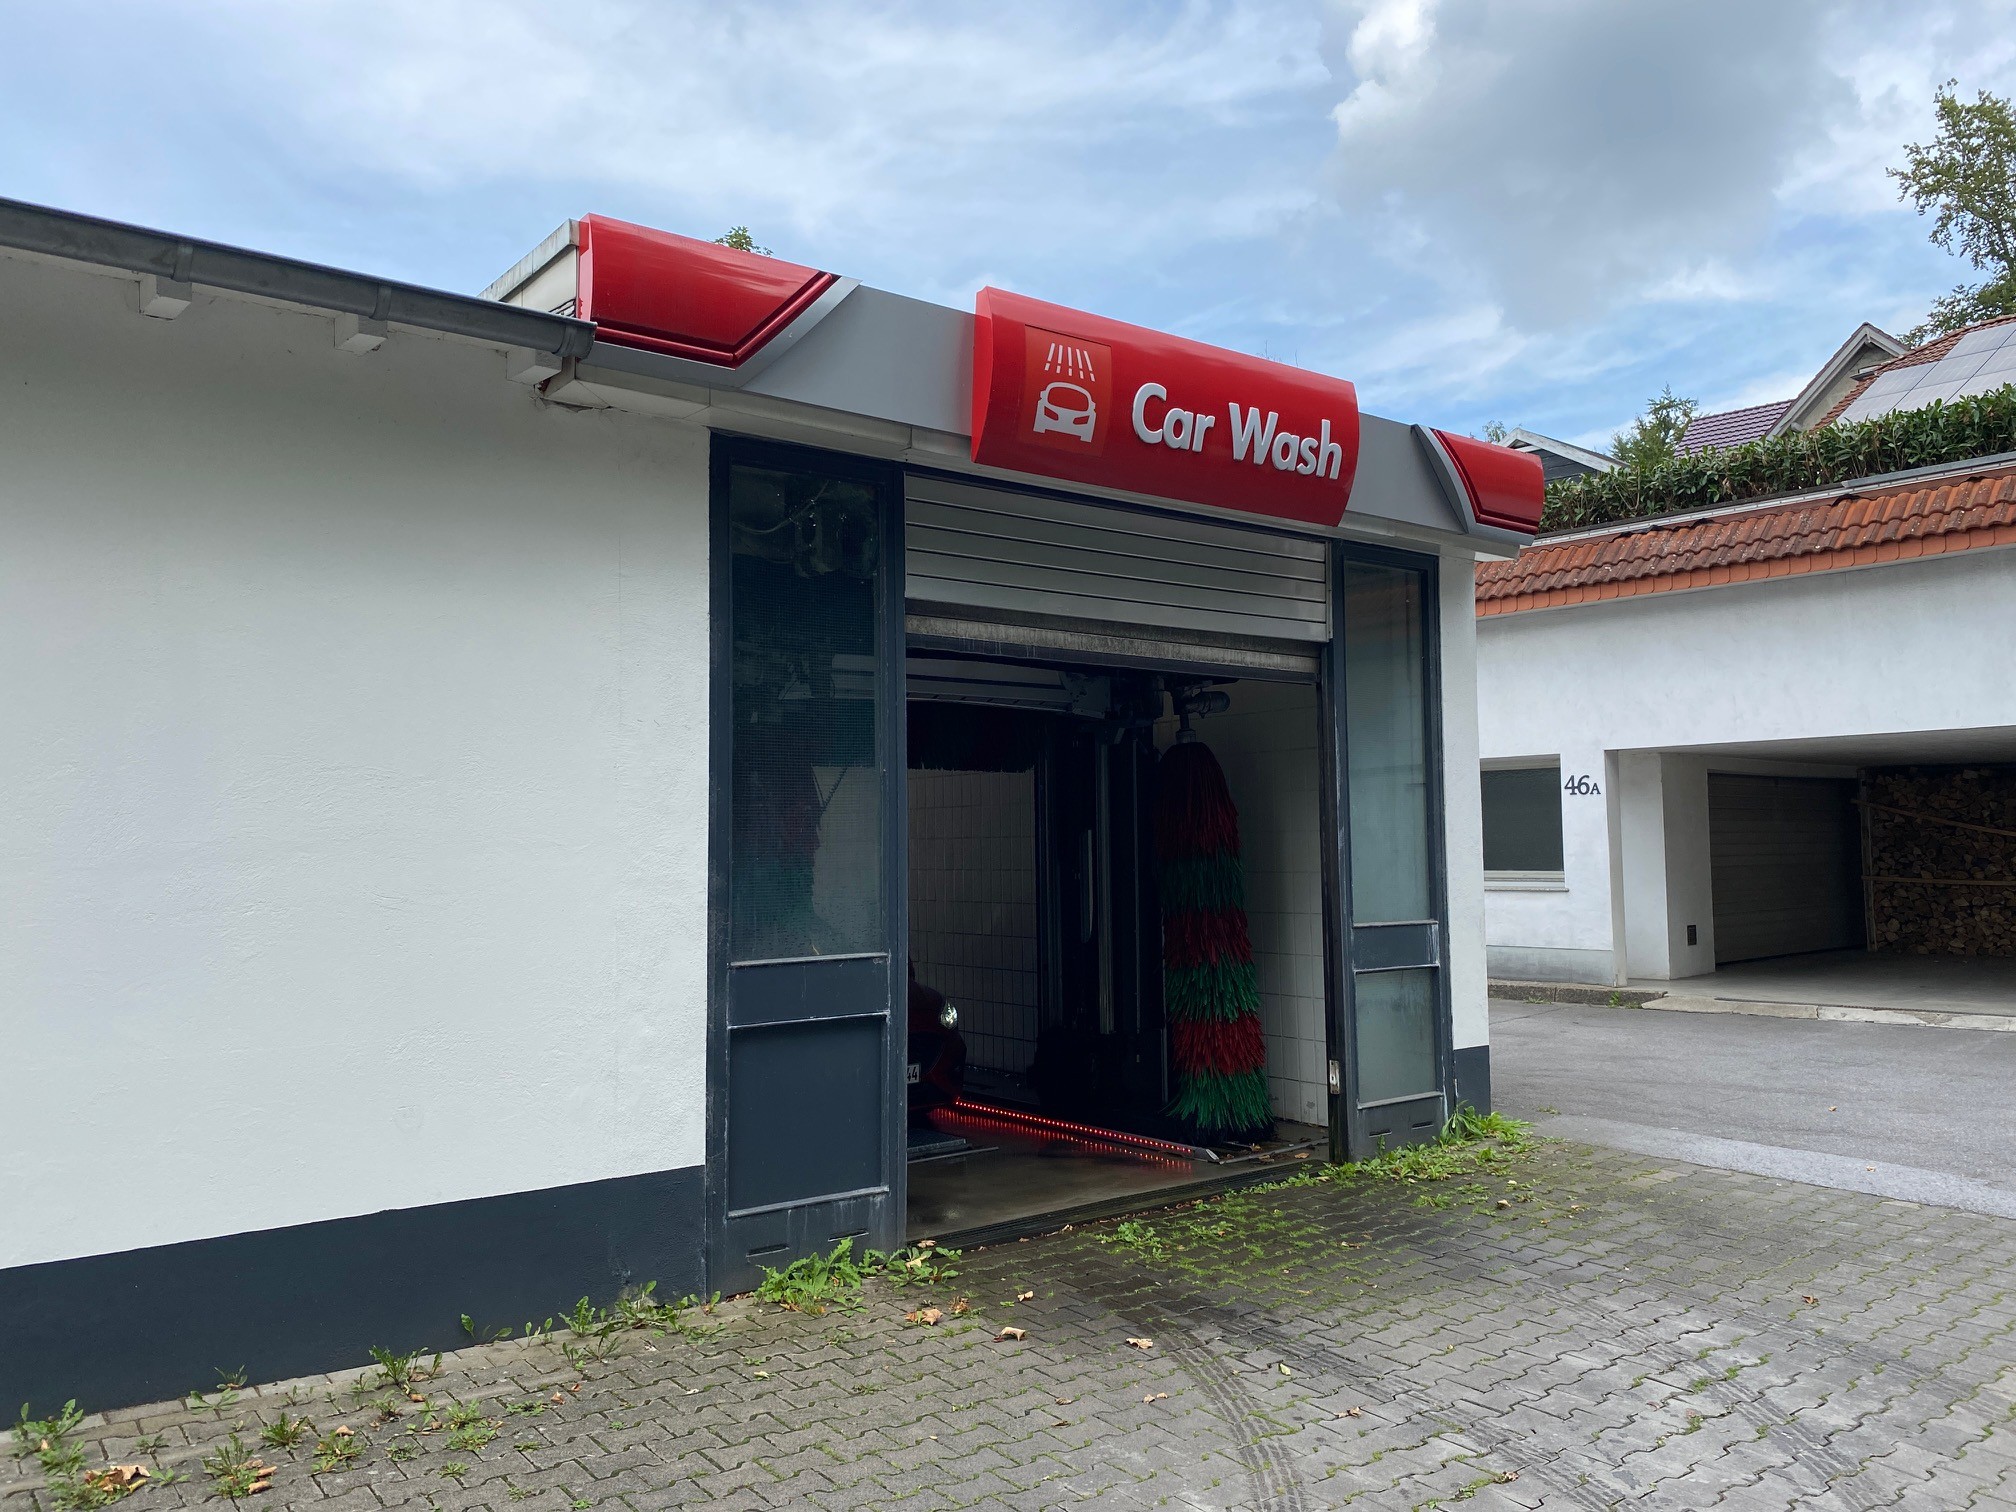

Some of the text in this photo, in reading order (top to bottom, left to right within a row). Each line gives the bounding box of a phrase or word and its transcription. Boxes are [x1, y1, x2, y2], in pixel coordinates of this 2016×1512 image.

[1132, 382, 1342, 480] Car Wash
[1564, 775, 1601, 795] 46A
